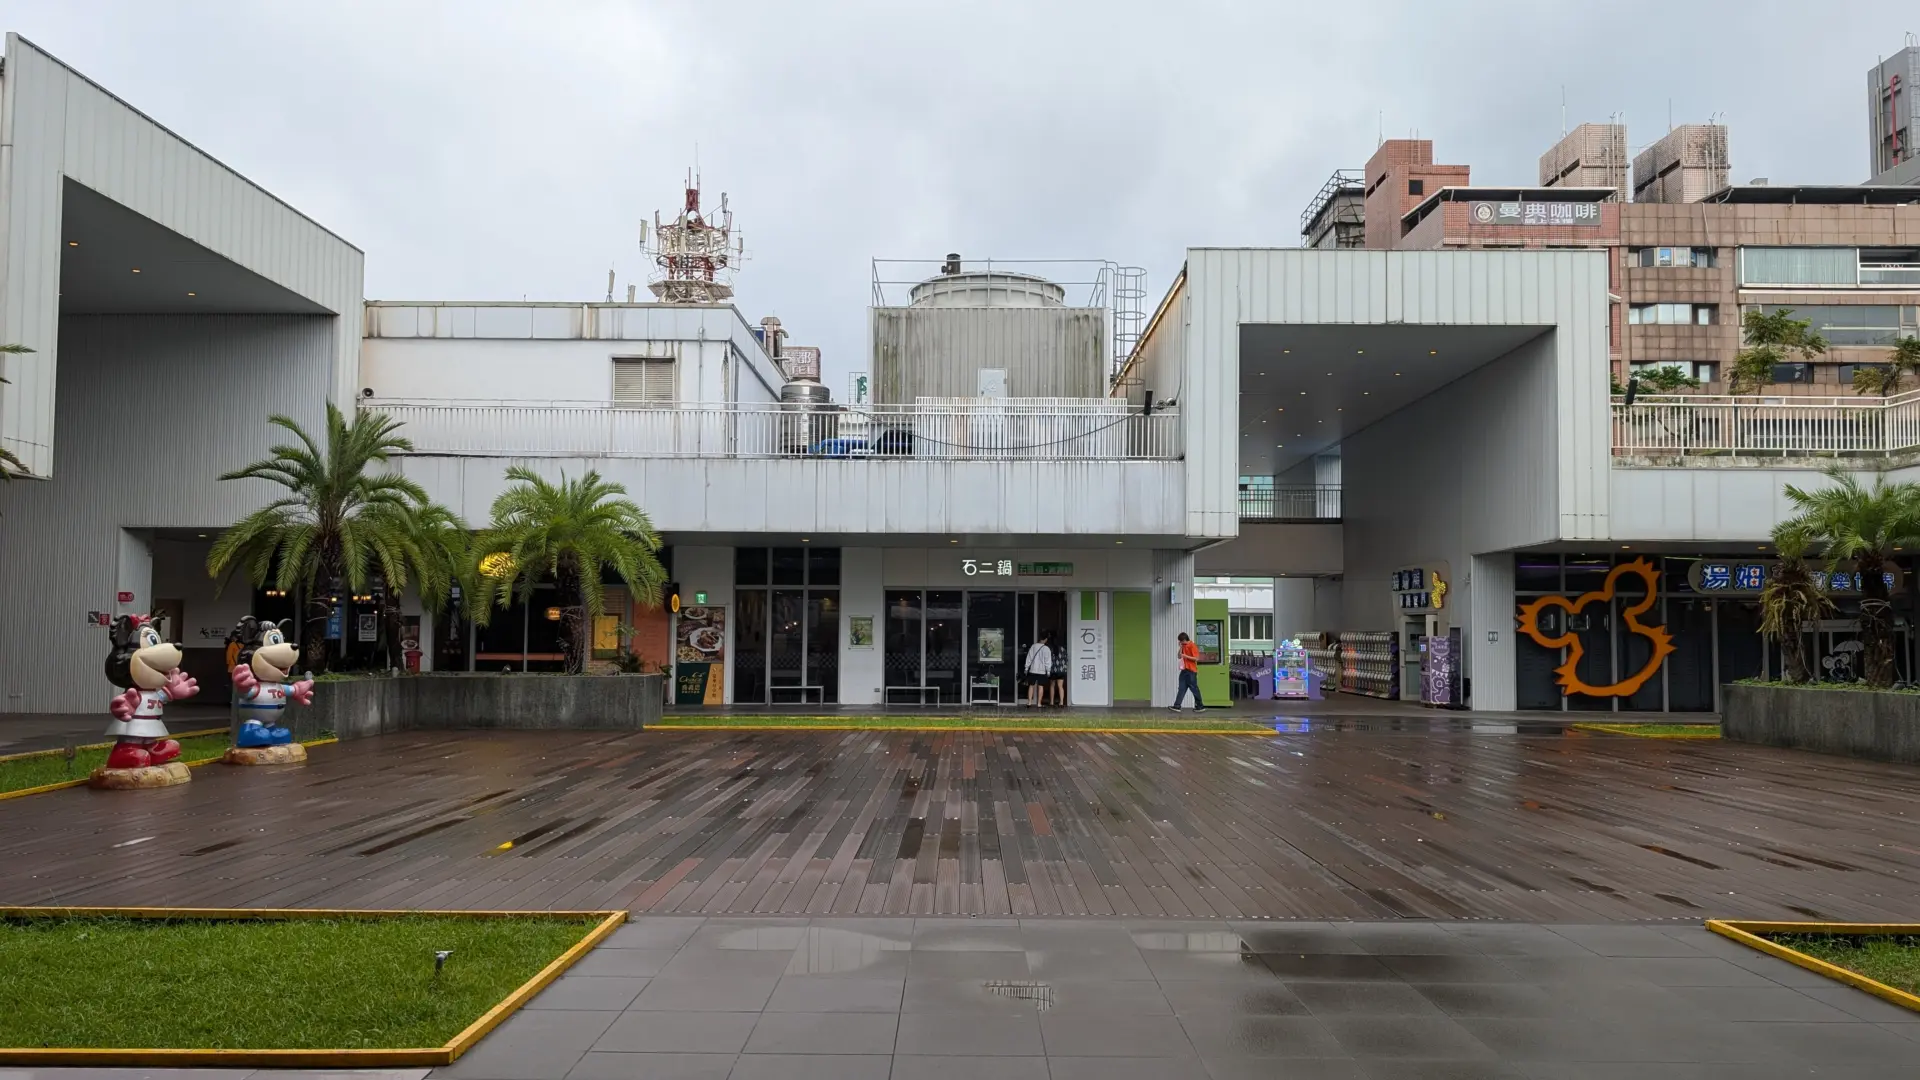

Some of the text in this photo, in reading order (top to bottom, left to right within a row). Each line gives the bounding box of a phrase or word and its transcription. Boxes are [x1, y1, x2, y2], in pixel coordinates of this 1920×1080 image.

[1499, 202, 1597, 219] 曼典咖啡
[962, 559, 1012, 576] 石二鍋
[1700, 563, 1785, 590] 湯姆
[1080, 628, 1097, 681] 石二鍋
